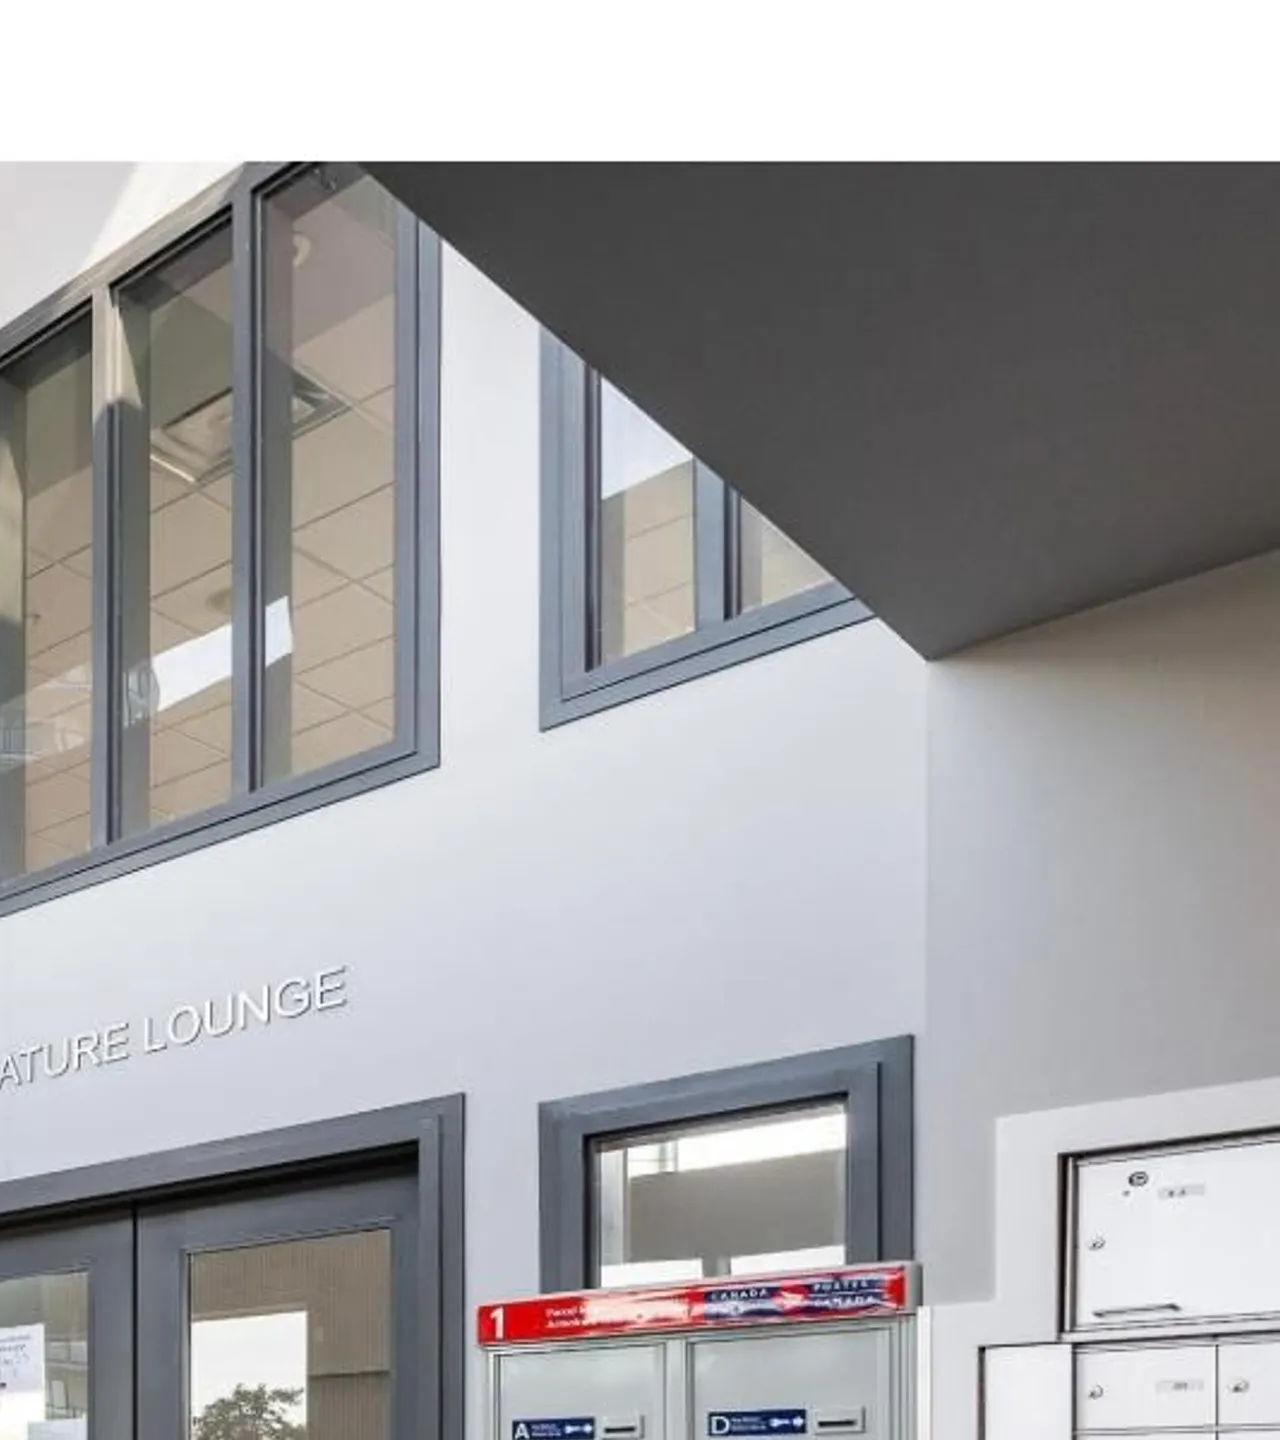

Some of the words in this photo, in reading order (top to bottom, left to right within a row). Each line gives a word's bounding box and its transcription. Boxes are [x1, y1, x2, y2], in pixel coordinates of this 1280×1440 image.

[143, 966, 350, 1055] LOUNGE
[490, 1307, 505, 1340] 1
[514, 1422, 530, 1440] A
[711, 1415, 730, 1435] D
